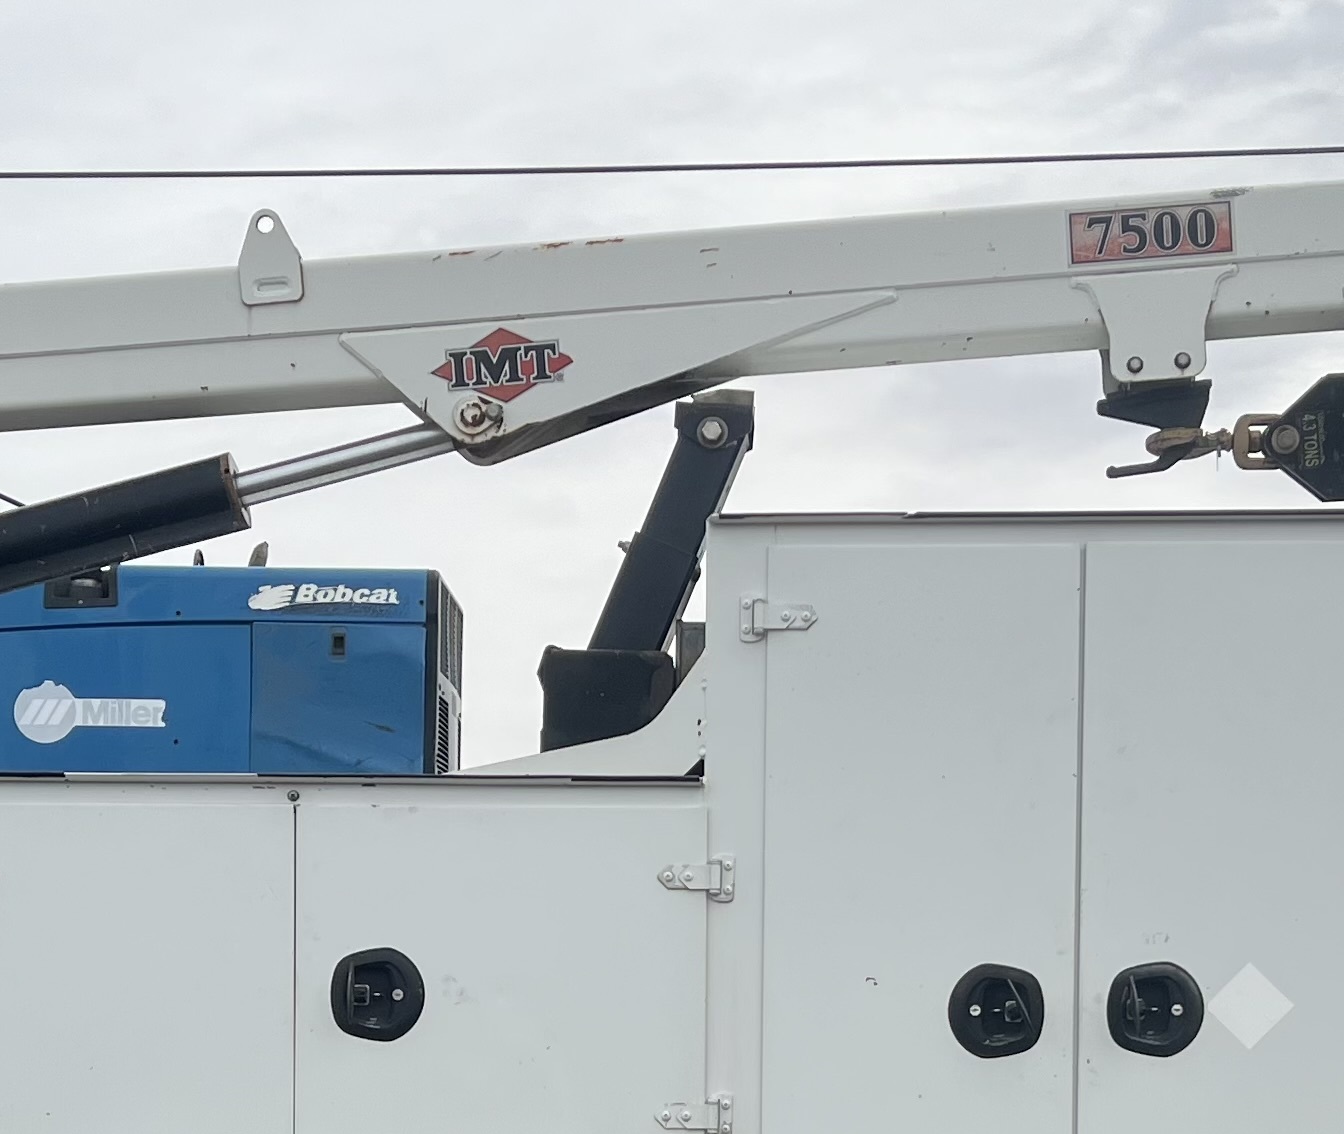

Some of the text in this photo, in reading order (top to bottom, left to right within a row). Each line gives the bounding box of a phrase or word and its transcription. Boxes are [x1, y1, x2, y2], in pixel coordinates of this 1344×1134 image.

[1083, 205, 1217, 258] 7500
[444, 338, 560, 392] IMT
[1303, 435, 1319, 467] TONS
[295, 583, 400, 604] Bobcat
[82, 700, 163, 724] Miller
